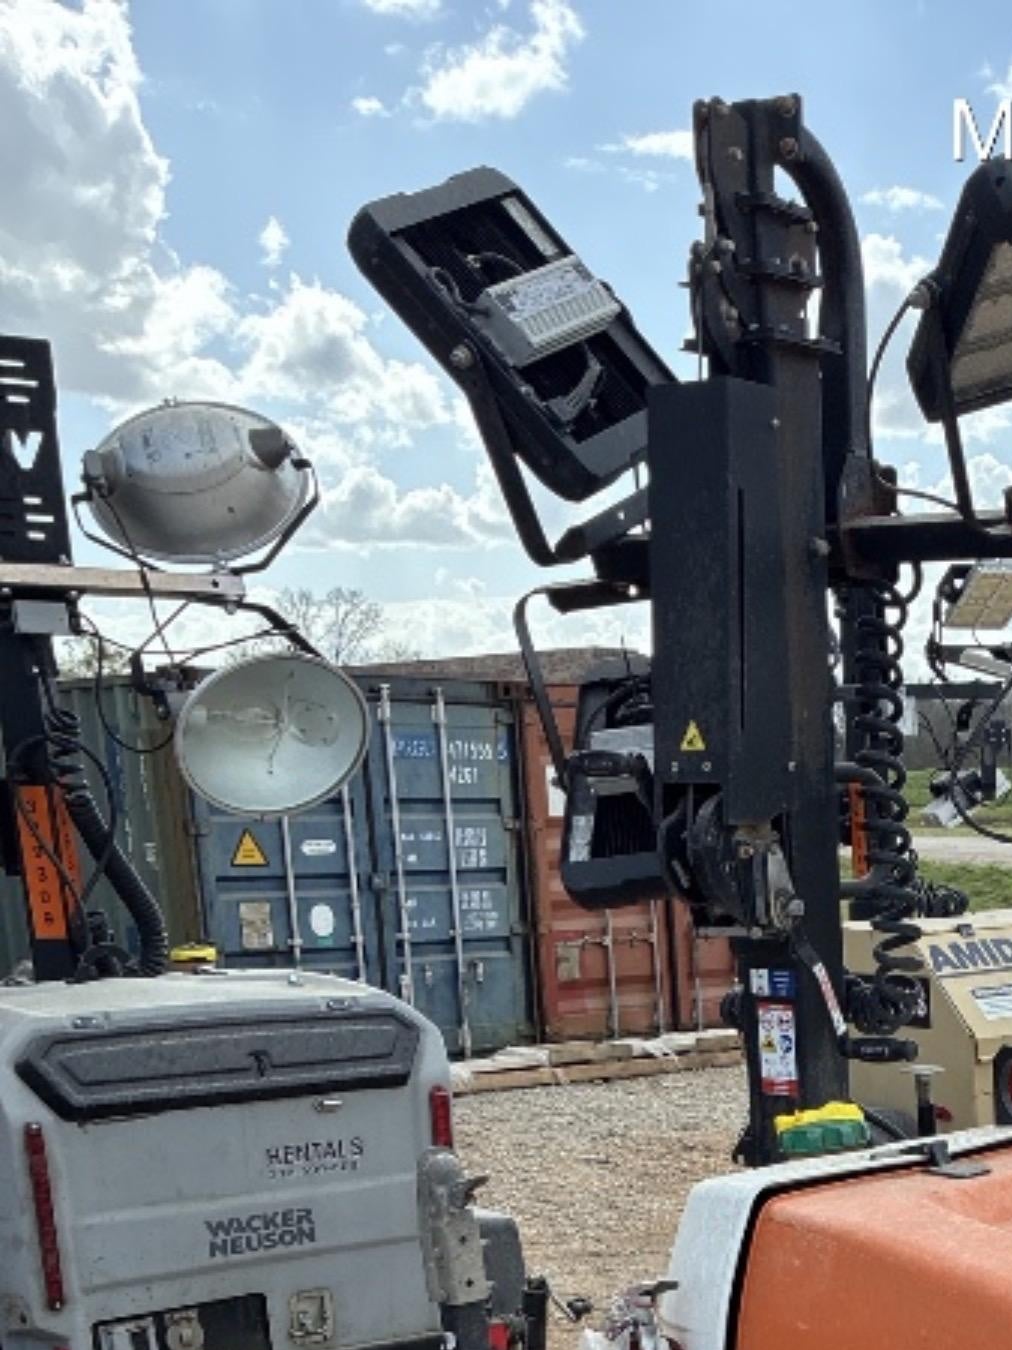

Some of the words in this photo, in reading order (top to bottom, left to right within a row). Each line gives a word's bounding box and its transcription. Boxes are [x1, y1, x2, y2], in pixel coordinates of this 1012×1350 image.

[266, 1136, 364, 1166] RENTALS
[204, 1207, 315, 1239] WACKER
[208, 1226, 316, 1258] NEUSON
